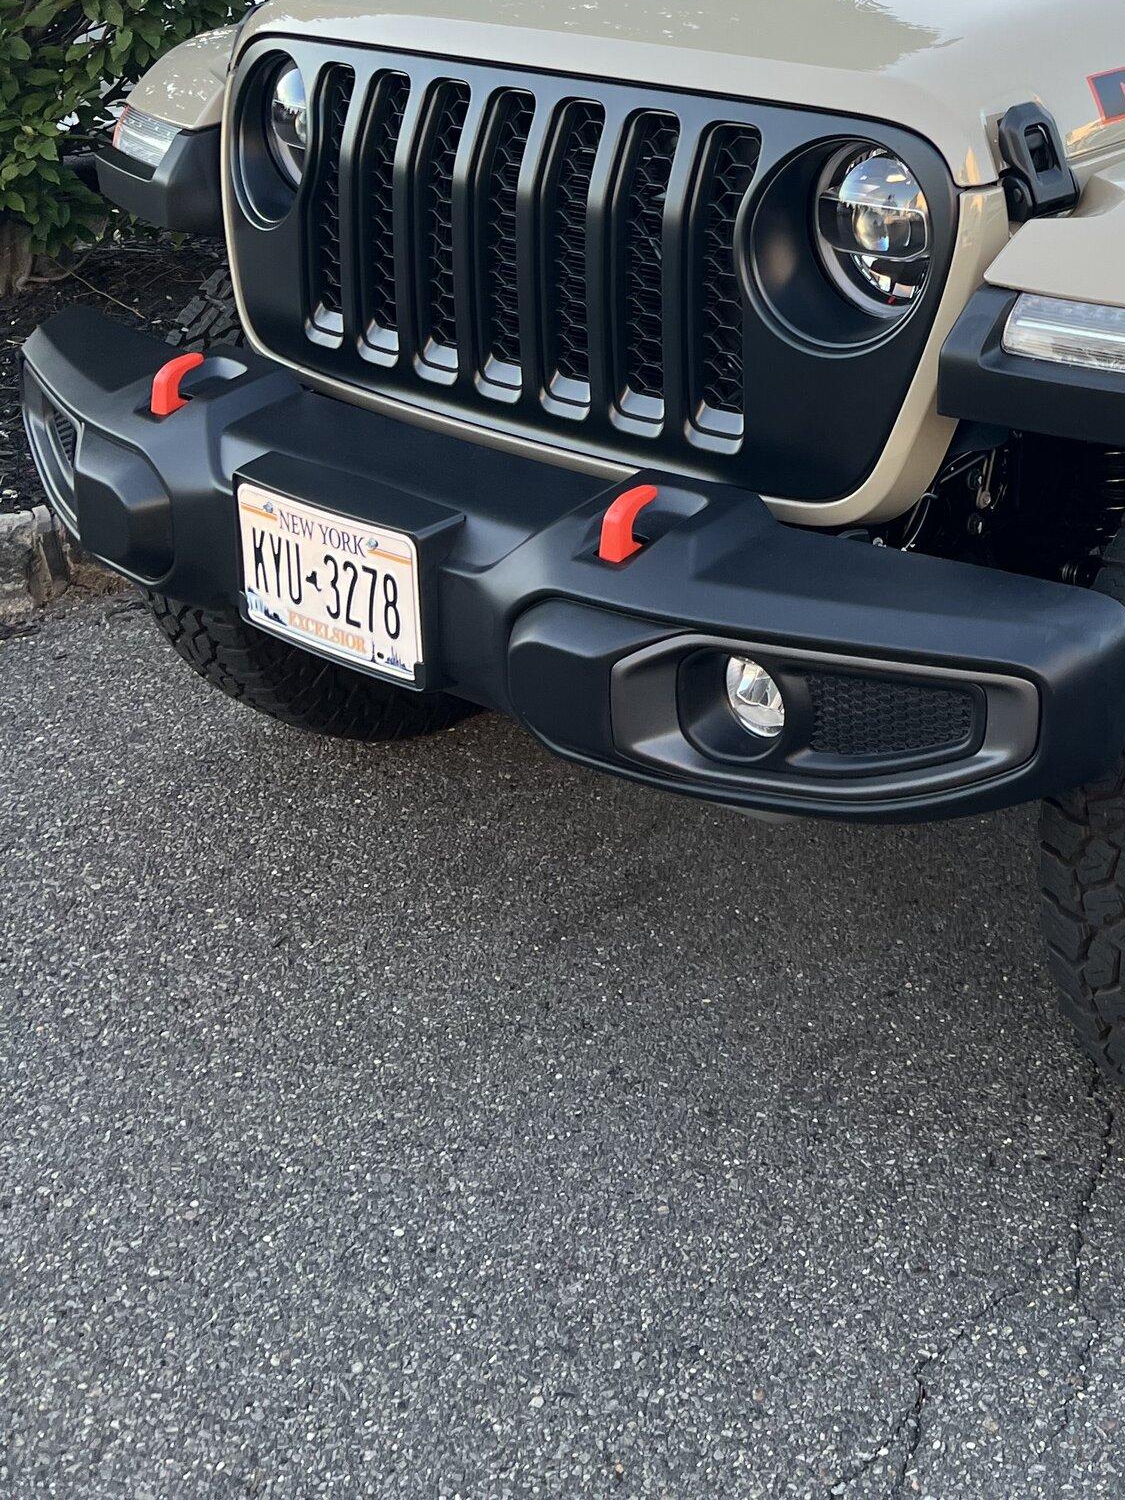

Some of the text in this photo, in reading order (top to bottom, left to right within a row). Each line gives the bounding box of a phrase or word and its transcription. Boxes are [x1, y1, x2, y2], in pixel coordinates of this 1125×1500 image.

[279, 509, 367, 558] NEW YORK
[252, 526, 401, 640] KYU 3278
[287, 609, 367, 654] EXCELSIOR
